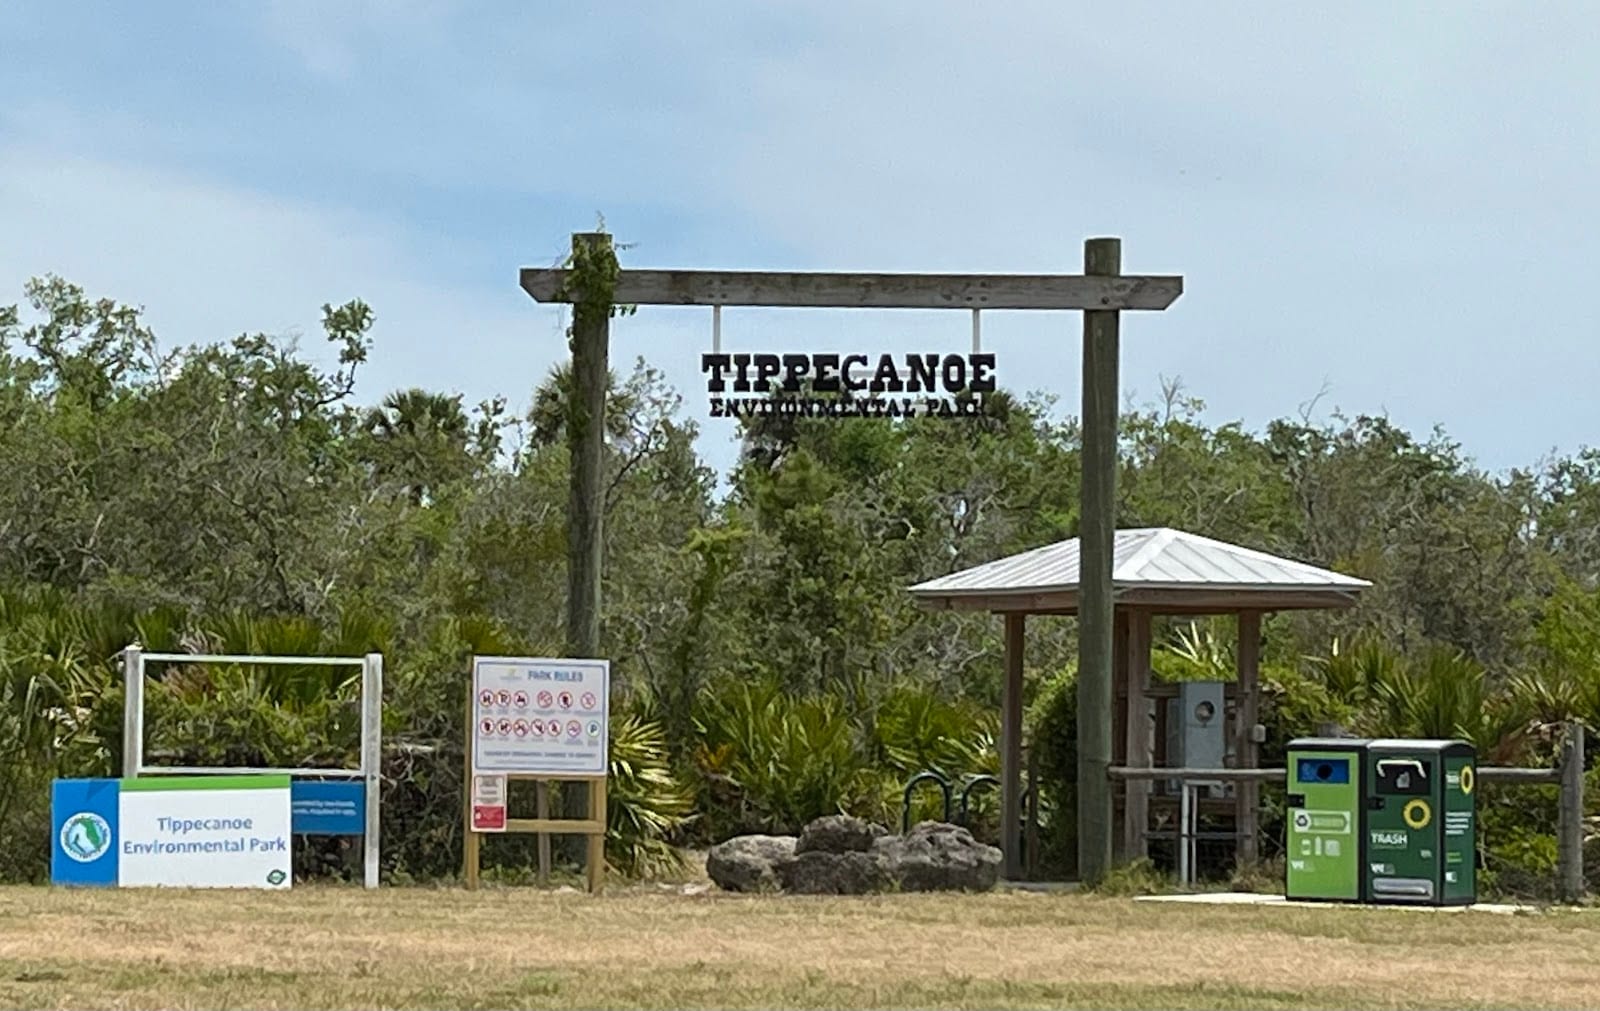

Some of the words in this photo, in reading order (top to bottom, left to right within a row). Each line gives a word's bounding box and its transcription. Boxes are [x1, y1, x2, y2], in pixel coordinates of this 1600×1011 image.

[702, 353, 996, 393] TIPPECANOE
[527, 669, 552, 681] PARK
[157, 816, 253, 835] Tippecanoe
[123, 837, 245, 854] Environmental
[250, 836, 287, 852] Park
[1370, 832, 1408, 845] TRASH
